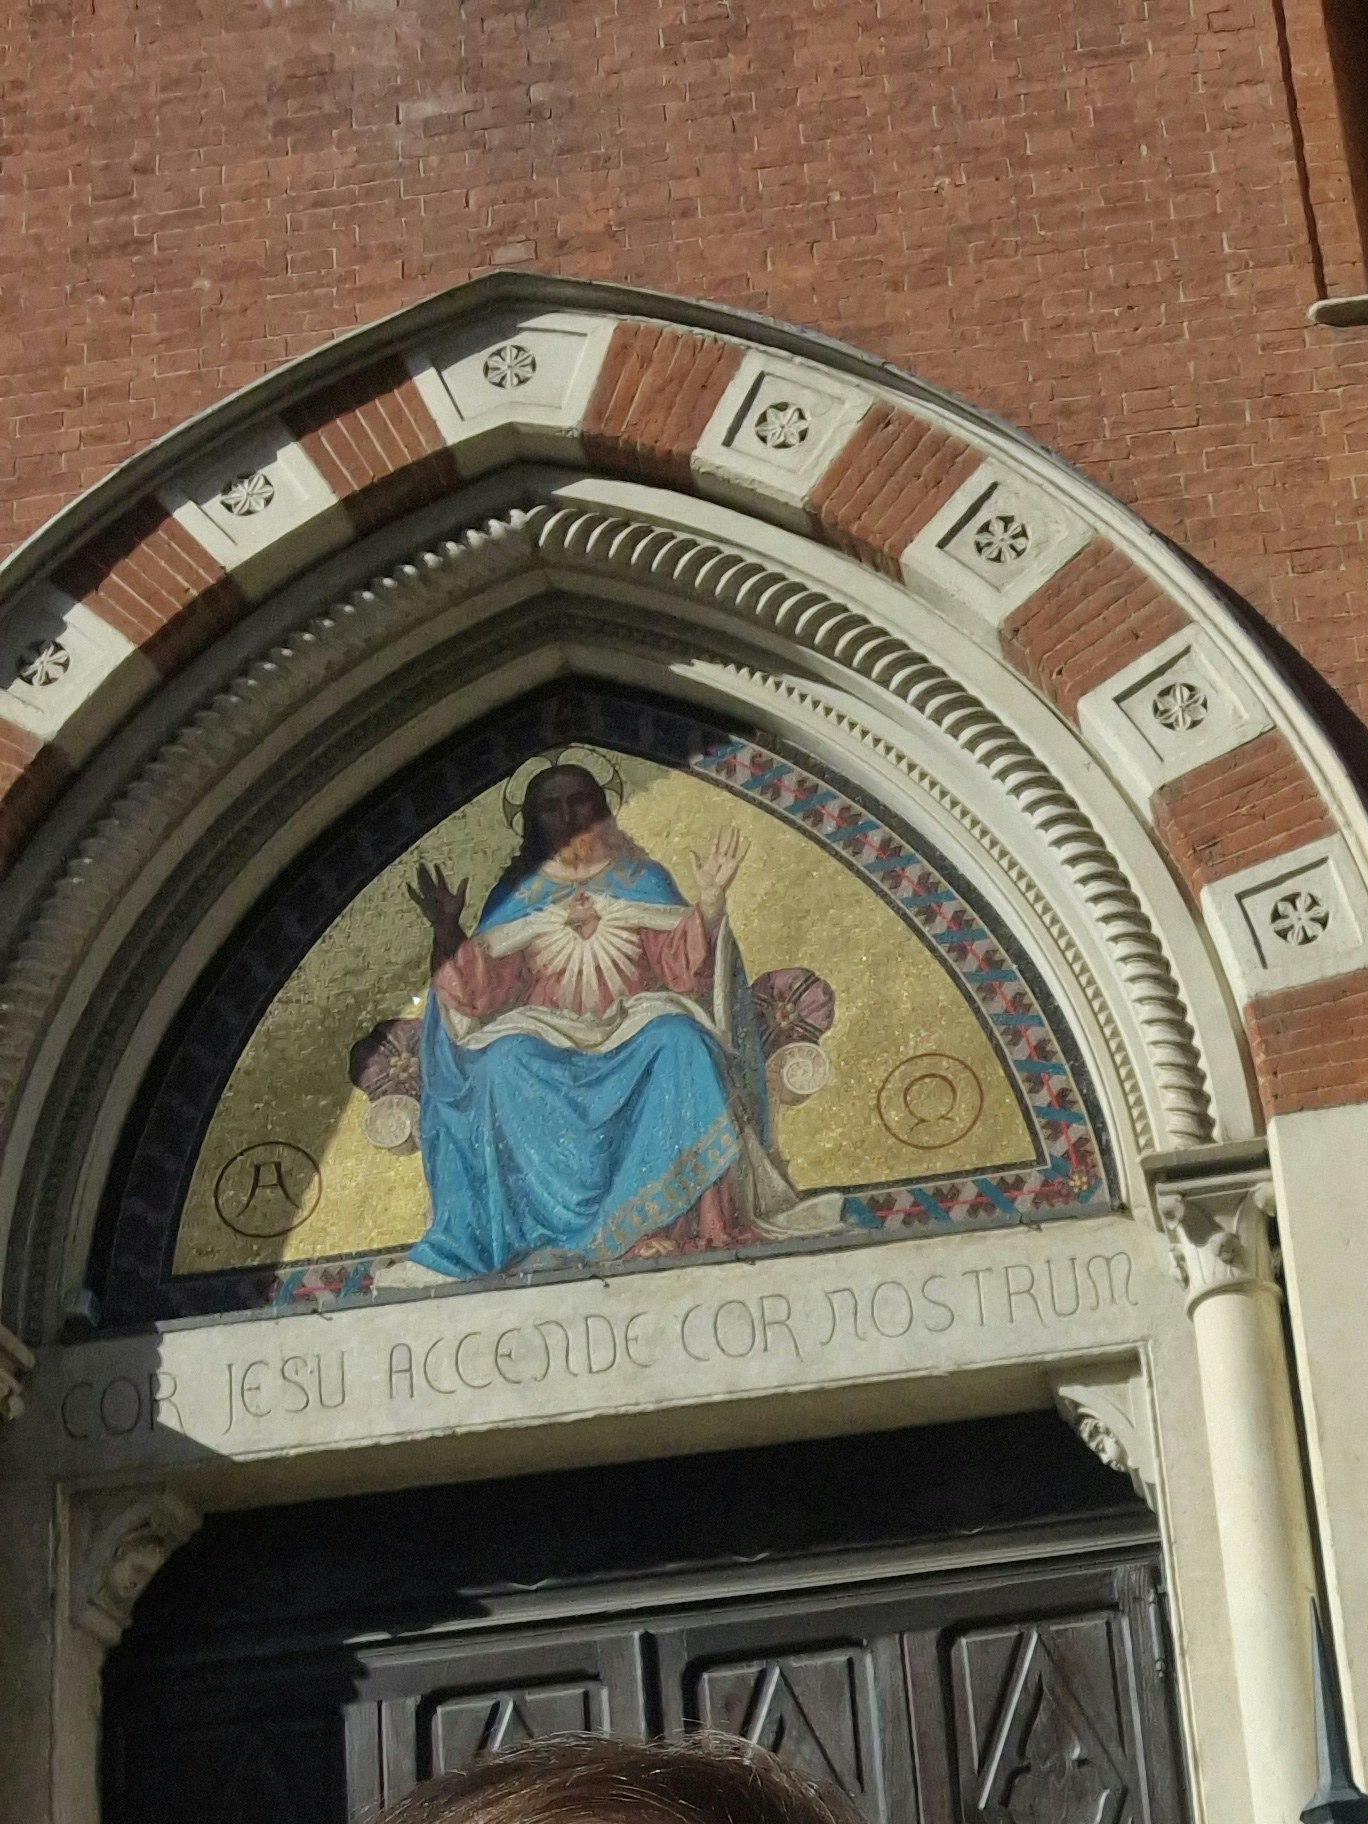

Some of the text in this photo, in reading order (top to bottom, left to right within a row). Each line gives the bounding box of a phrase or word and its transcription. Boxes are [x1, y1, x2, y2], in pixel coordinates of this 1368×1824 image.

[60, 1250, 1139, 1439] COR JESU ACCENDE COR NOSTRUM
